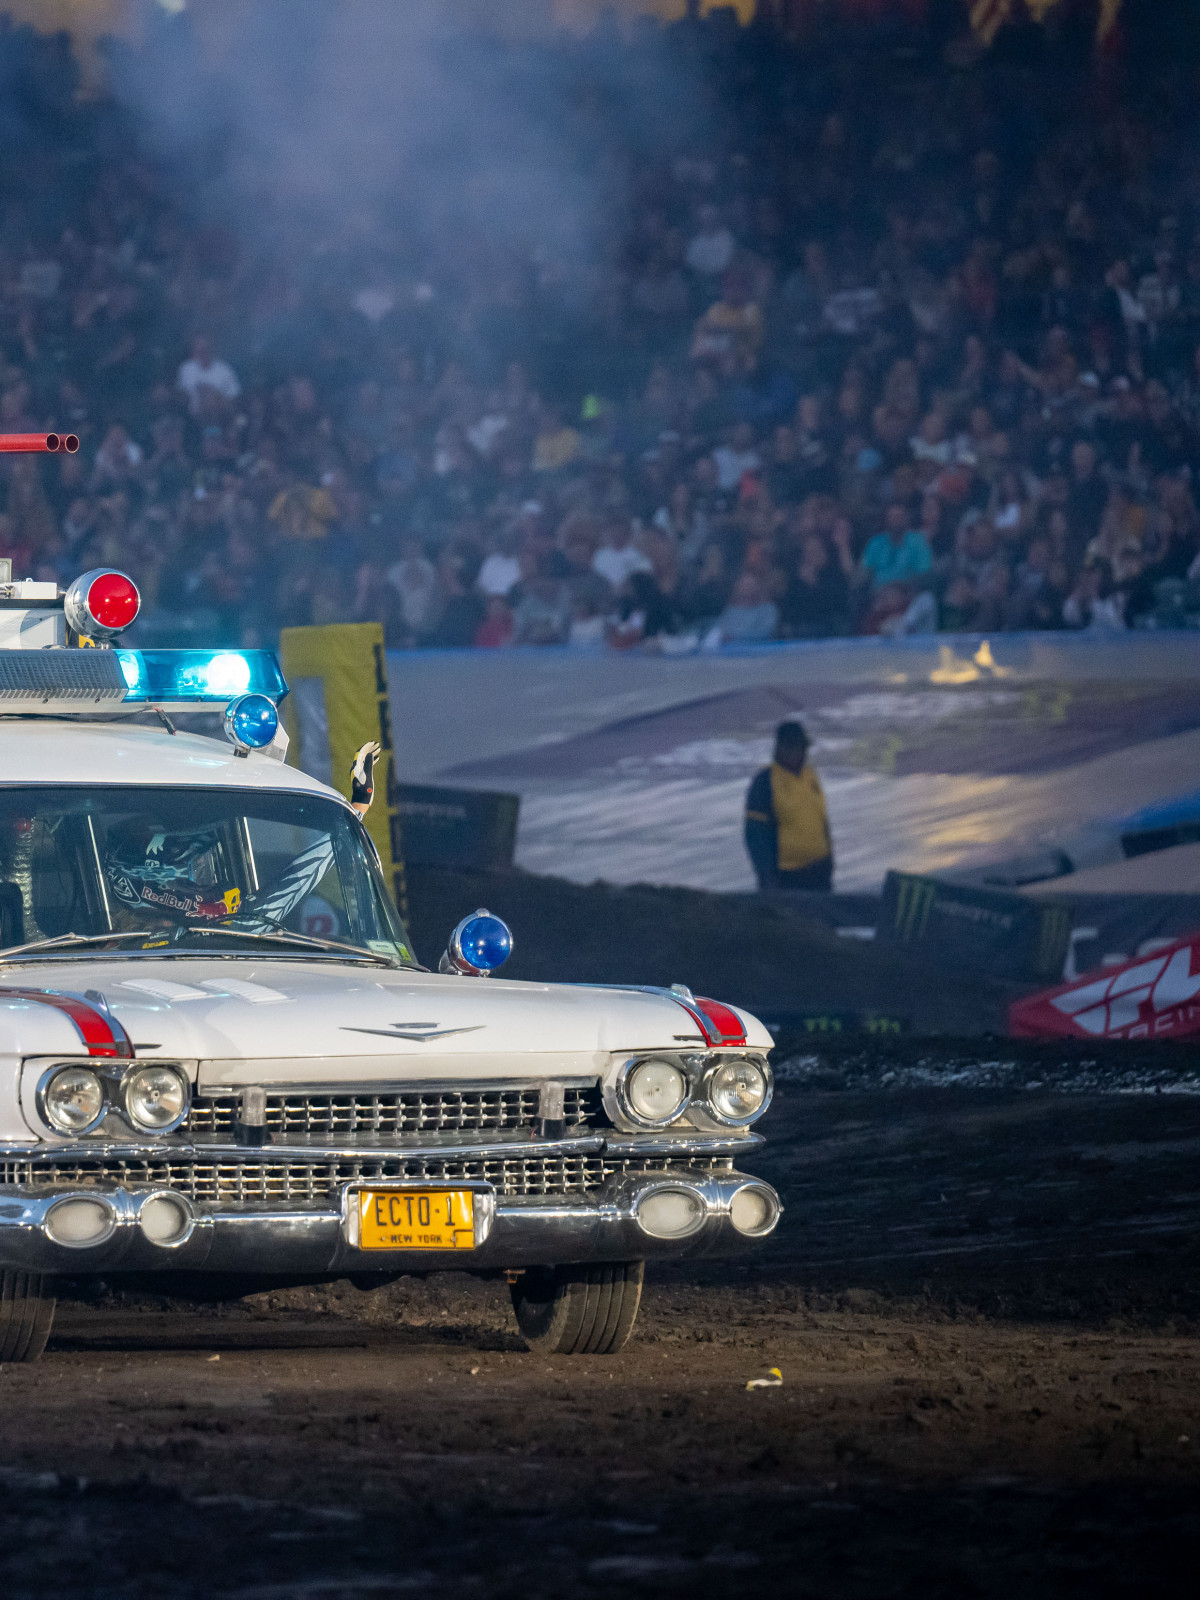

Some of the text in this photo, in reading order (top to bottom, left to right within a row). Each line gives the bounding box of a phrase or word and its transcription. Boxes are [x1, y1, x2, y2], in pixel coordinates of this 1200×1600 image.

[141, 886, 192, 911] Red Bull
[391, 1234, 443, 1244] NEW YORK
